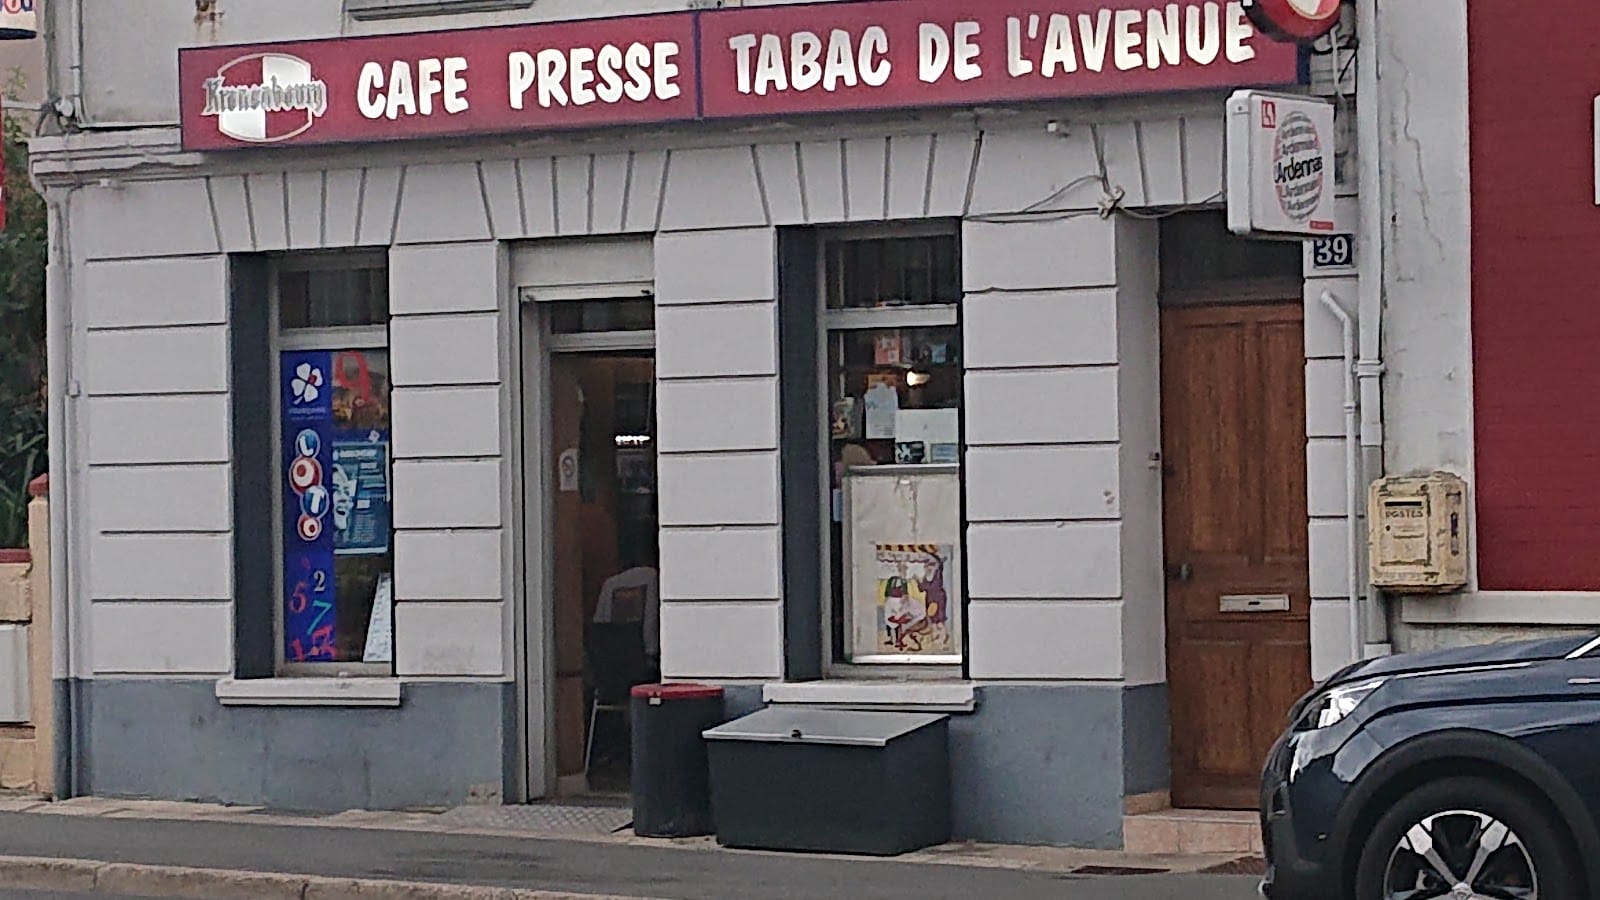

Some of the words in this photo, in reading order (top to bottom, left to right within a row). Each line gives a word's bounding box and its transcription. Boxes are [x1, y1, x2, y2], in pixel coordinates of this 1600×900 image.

[357, 57, 469, 119] CAFE
[509, 42, 681, 110] PRESSE
[729, 27, 892, 96] TABAC
[920, 22, 982, 83] DE
[1008, 2, 1255, 77] L'AVENUE
[1316, 236, 1348, 264] 39
